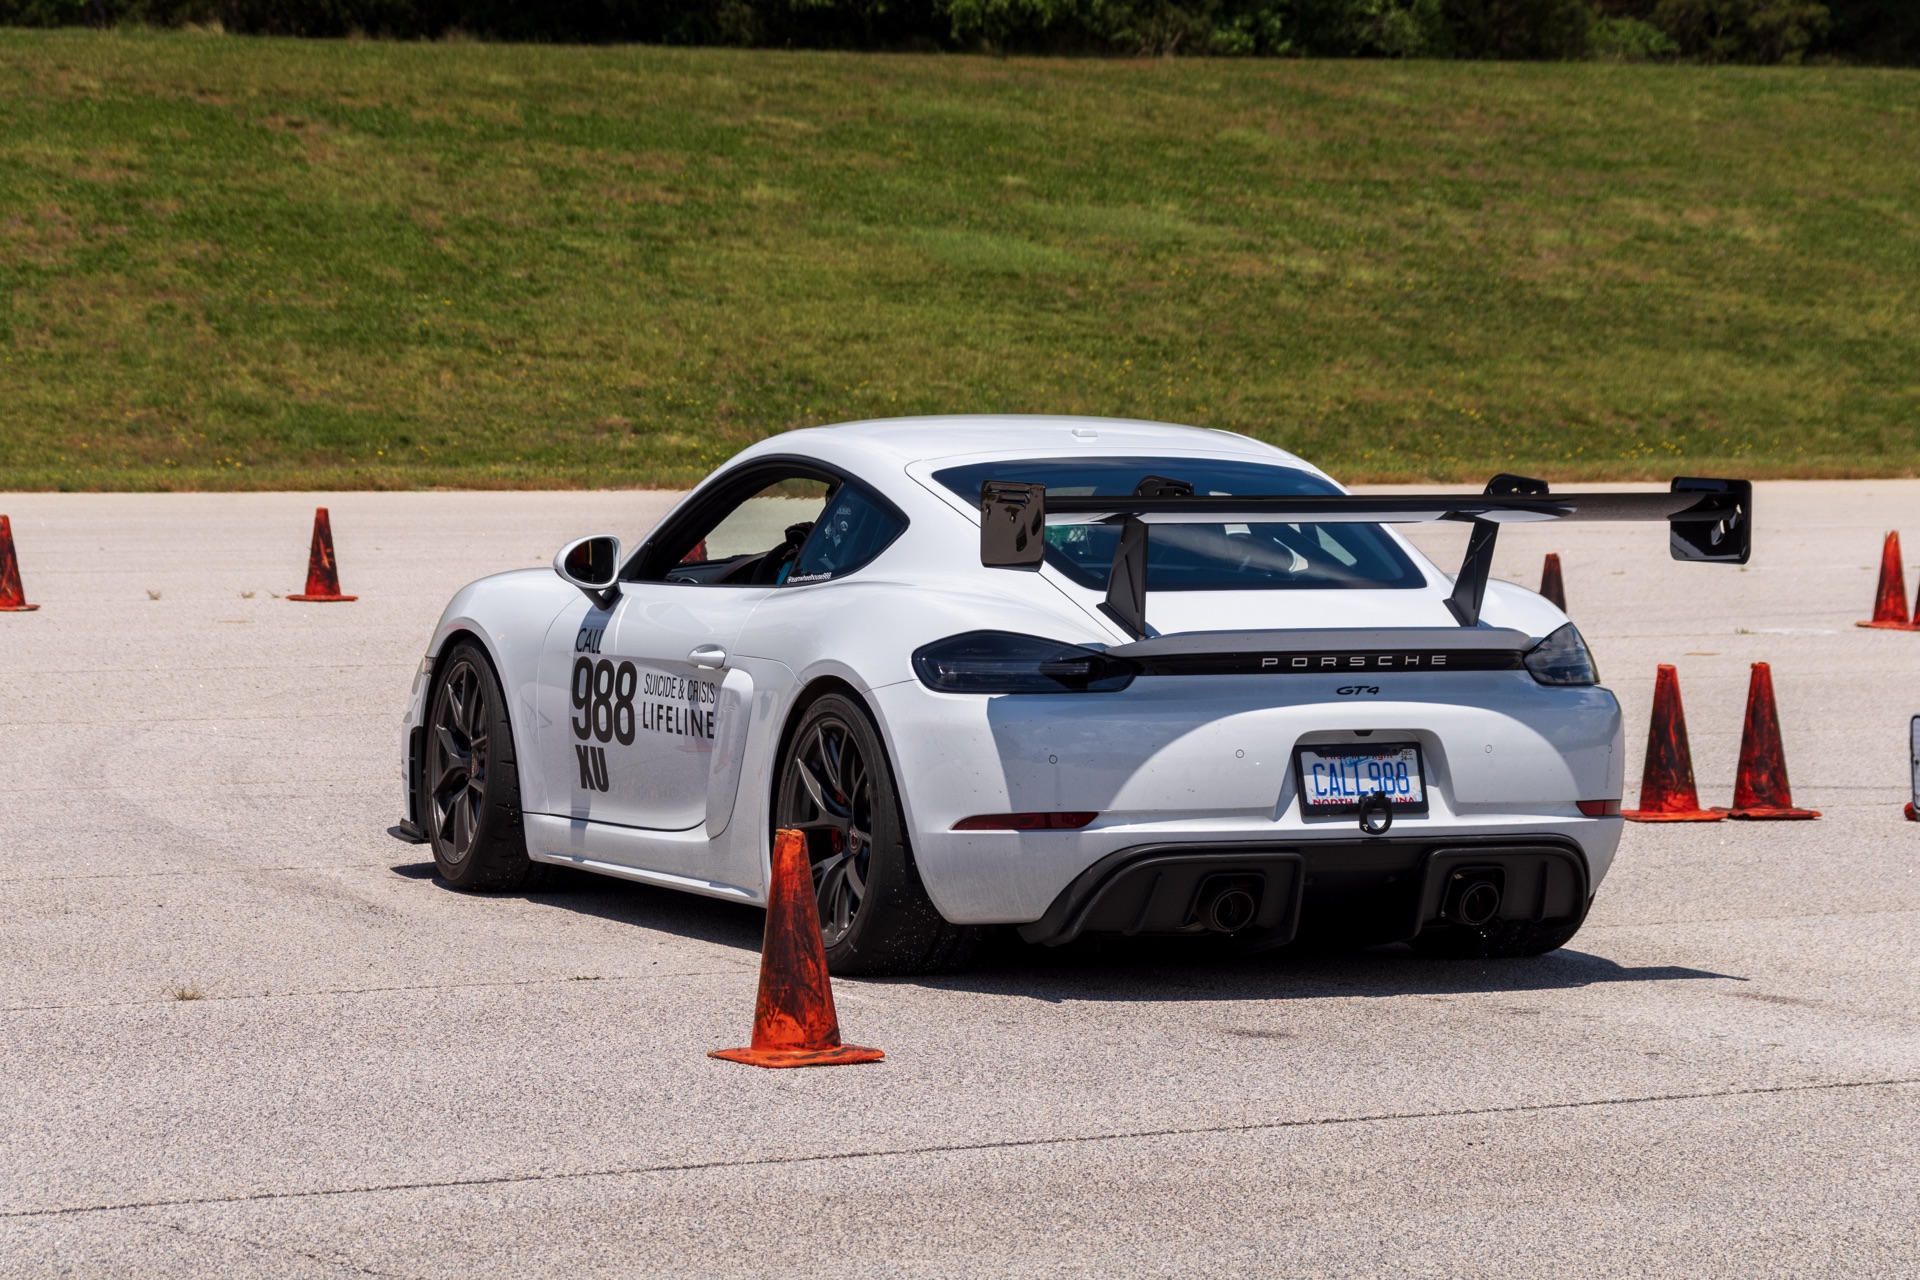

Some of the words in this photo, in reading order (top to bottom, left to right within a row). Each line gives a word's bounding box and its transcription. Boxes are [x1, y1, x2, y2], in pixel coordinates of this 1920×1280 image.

[575, 627, 604, 654] CALL
[1261, 655, 1447, 668] PORSCHE
[572, 656, 638, 746] 988
[644, 673, 677, 699] SUICIDE
[678, 680, 685, 701] &
[687, 680, 716, 704] CRISIS
[1336, 686, 1380, 696] GT4
[642, 701, 715, 739] LIFELINE
[575, 744, 610, 793] XU
[1312, 761, 1410, 796] CALL988
